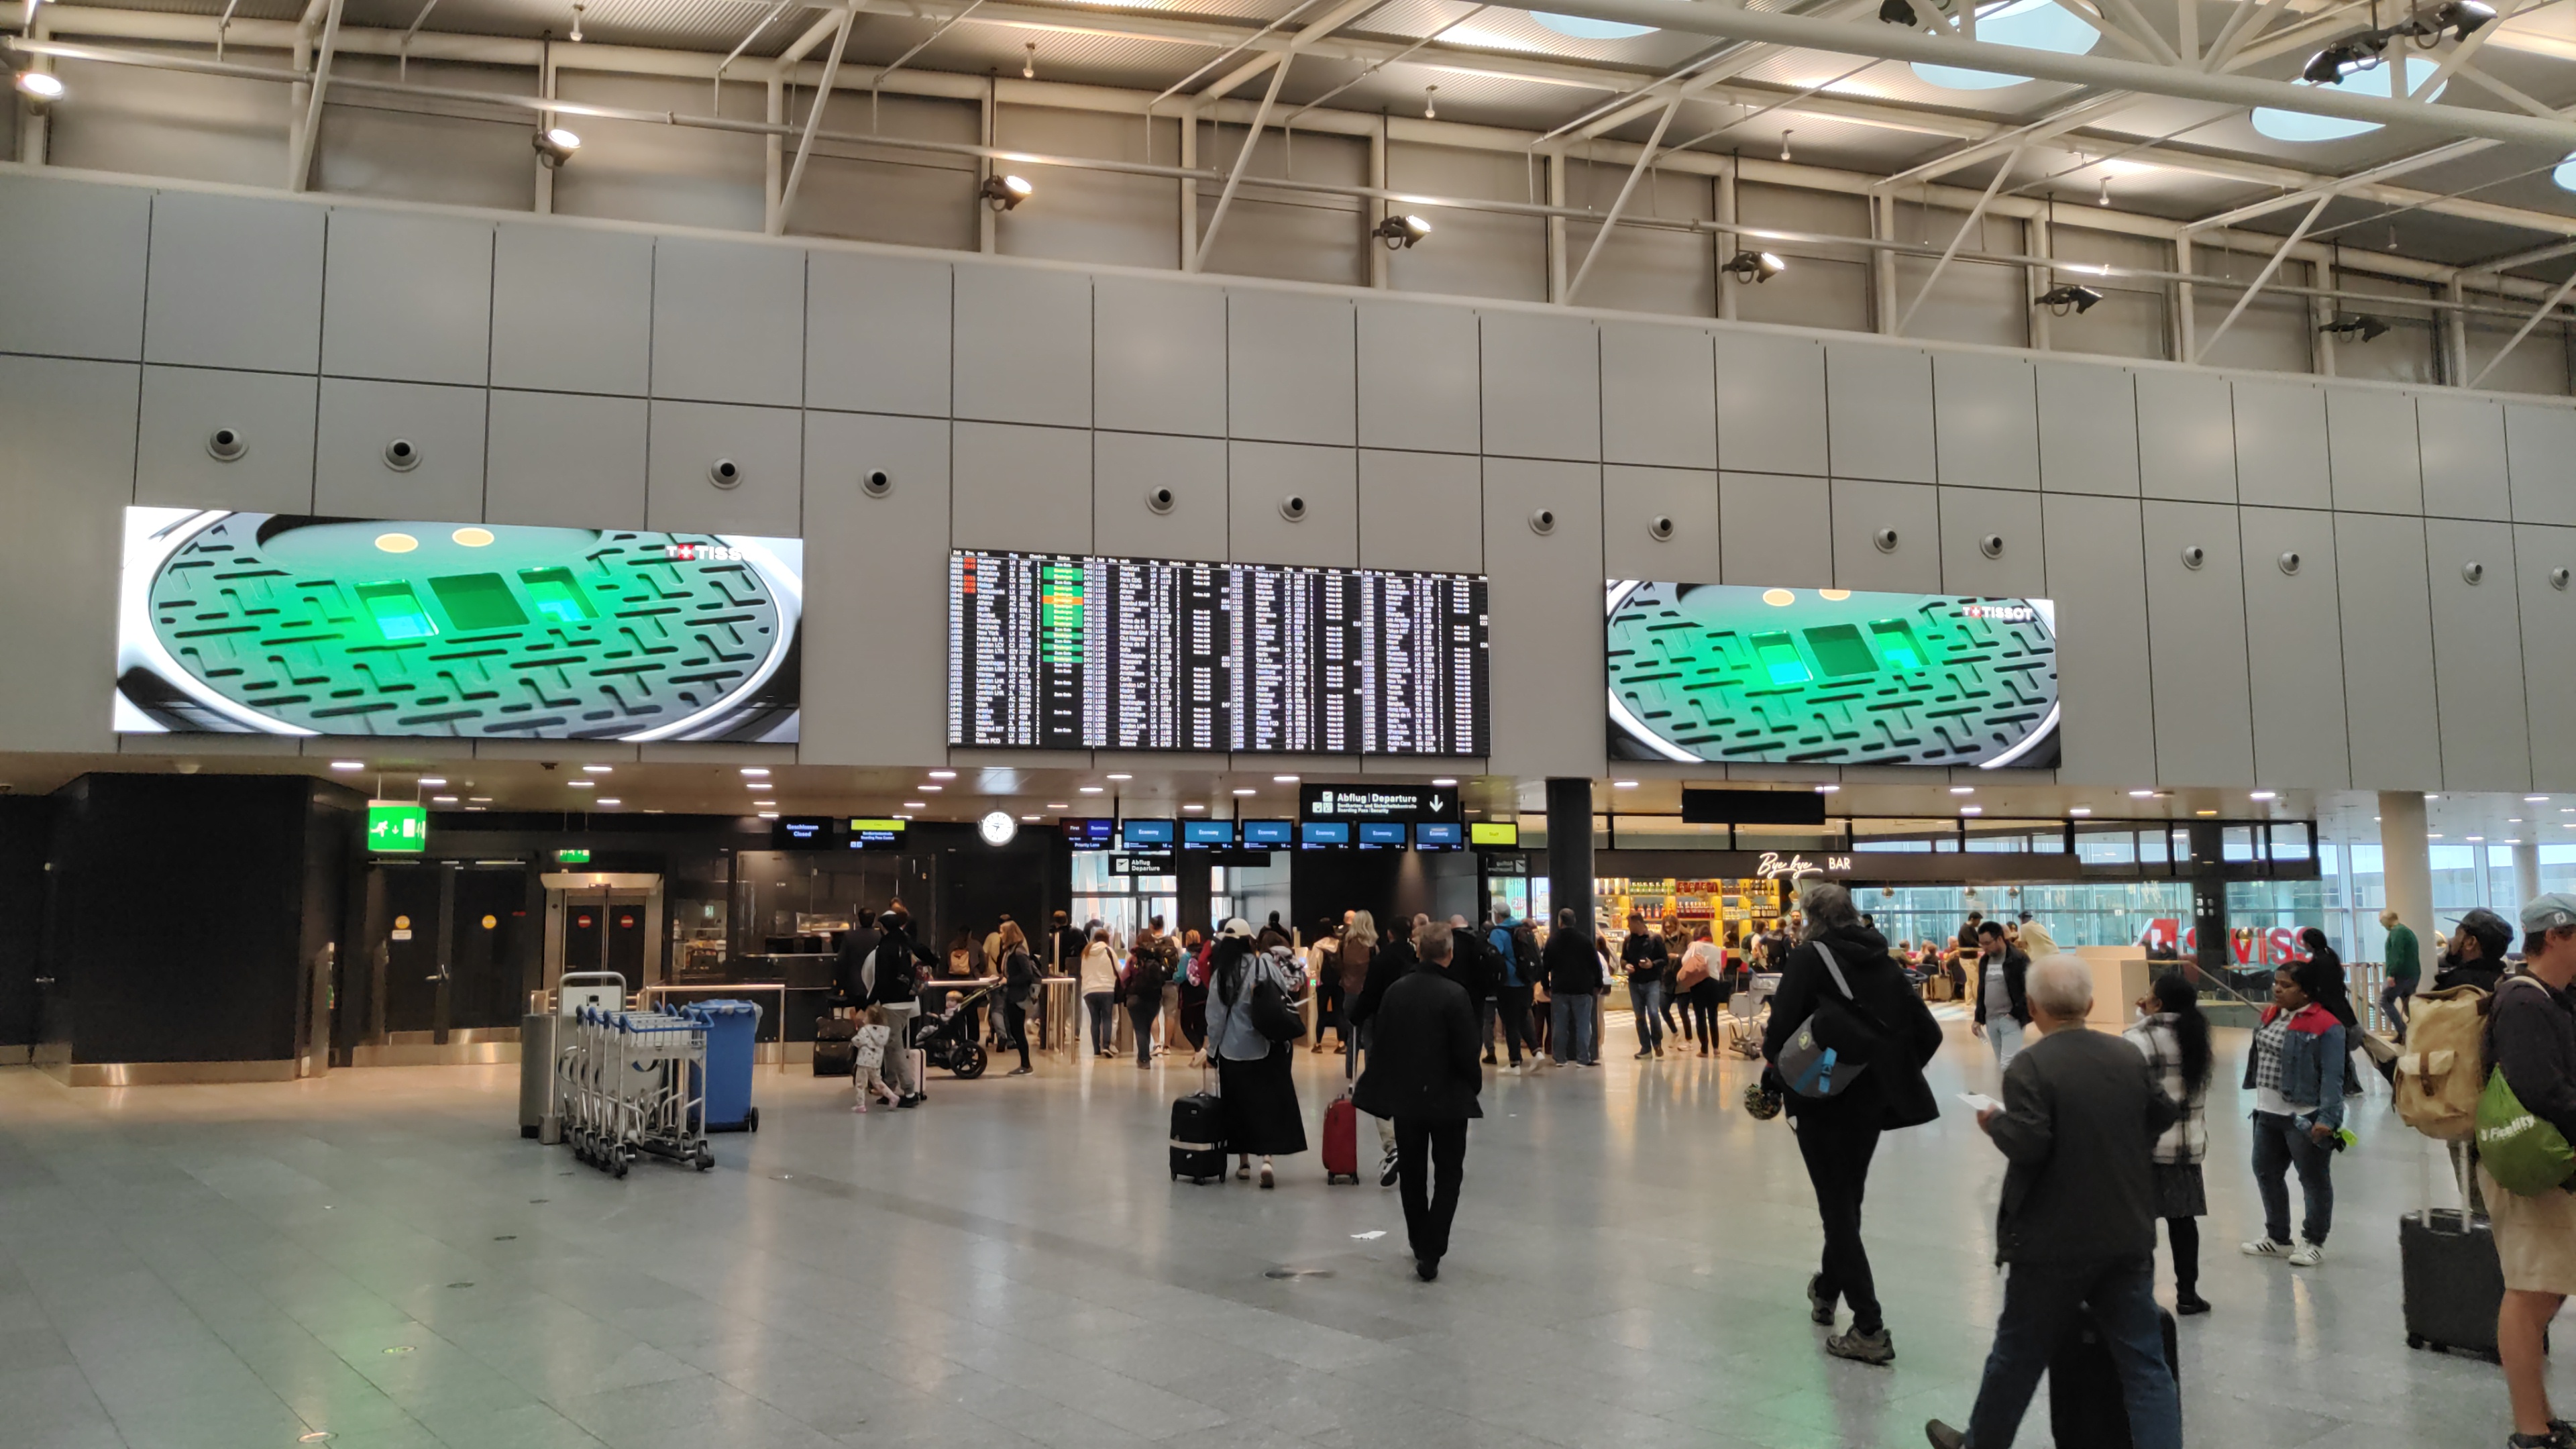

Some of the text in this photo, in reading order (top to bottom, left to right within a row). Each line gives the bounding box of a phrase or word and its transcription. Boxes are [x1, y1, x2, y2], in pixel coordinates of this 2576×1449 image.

[1982, 606, 2033, 621] TISSOT
[1338, 793, 1417, 803] Abflug Departure
[1757, 852, 1851, 879] Bye bye BAR
